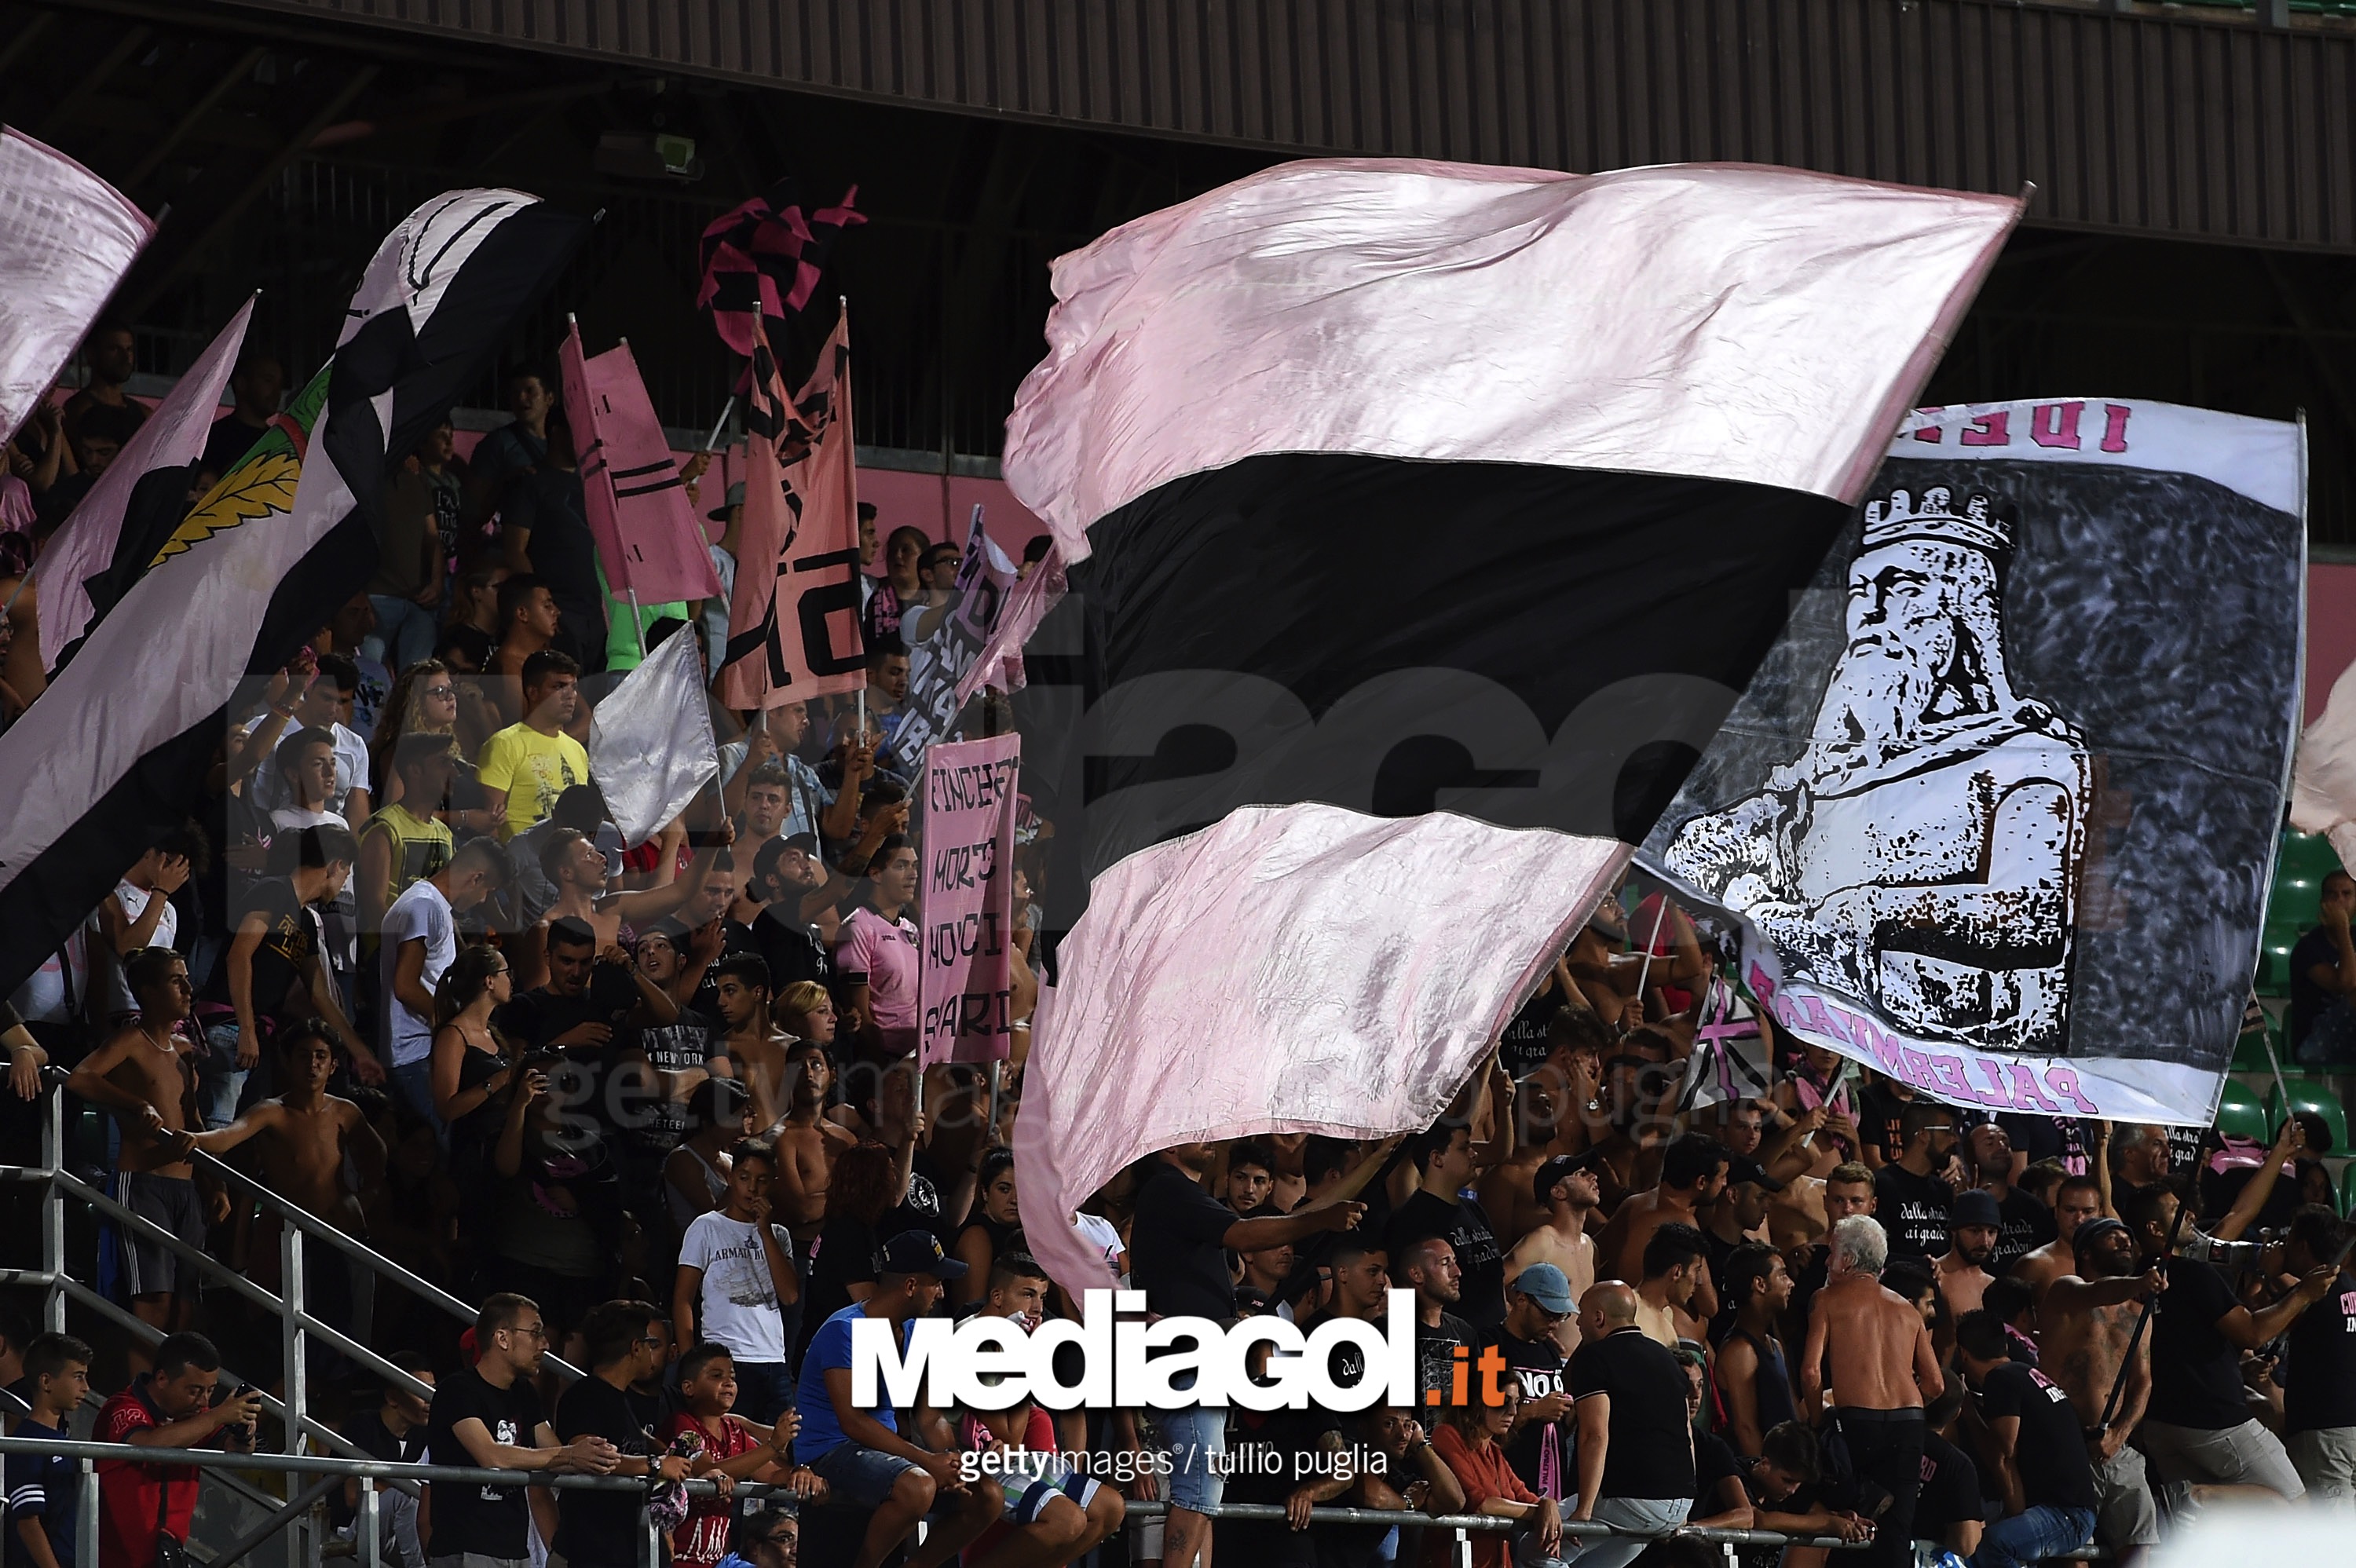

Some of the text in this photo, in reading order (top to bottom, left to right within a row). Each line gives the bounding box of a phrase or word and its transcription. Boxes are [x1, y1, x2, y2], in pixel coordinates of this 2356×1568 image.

[657, 1051, 675, 1064] NEW
[1901, 1201, 1928, 1221] dalla
[1904, 1225, 1918, 1240] ai
[715, 1247, 752, 1262] ARMATA
[1341, 1351, 1365, 1377] dall
